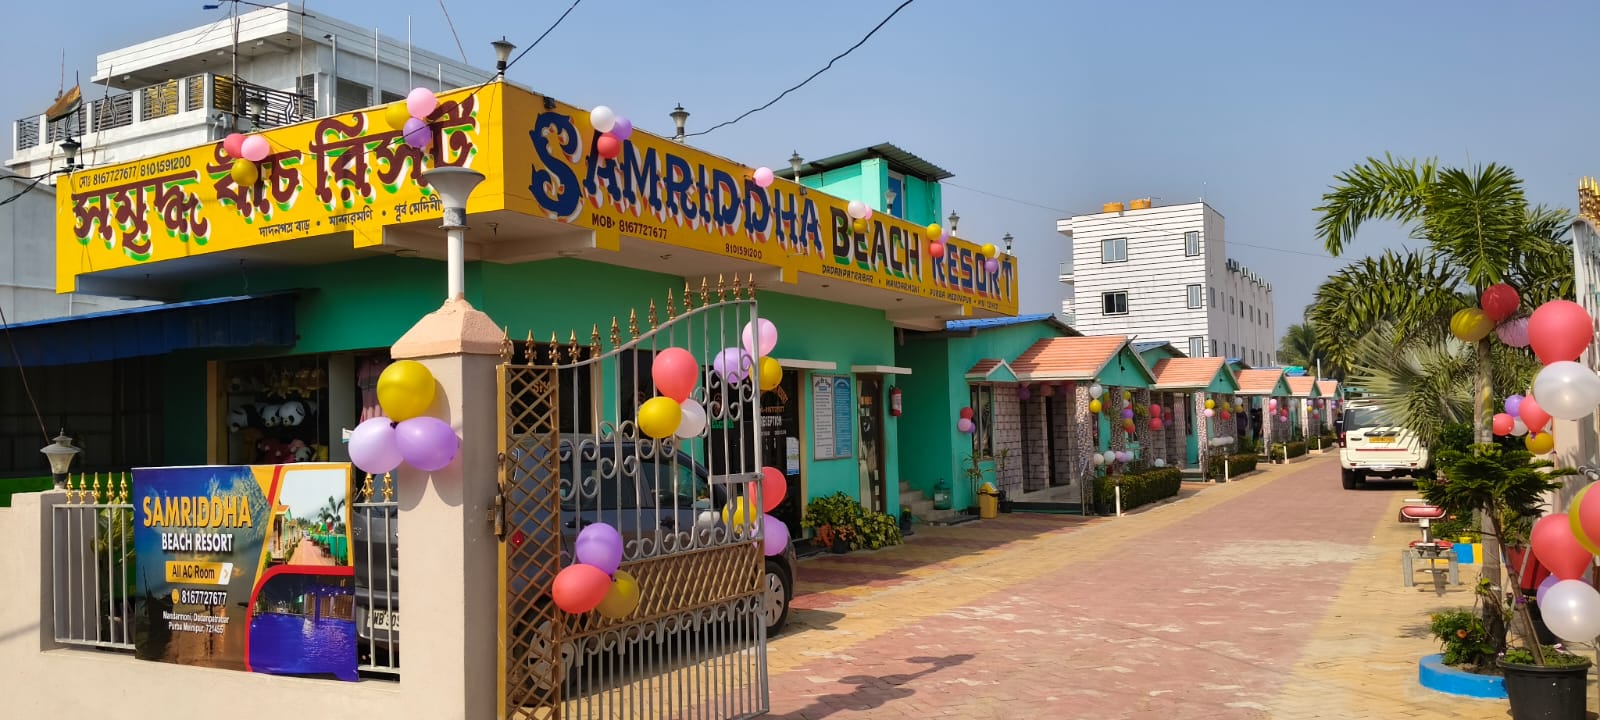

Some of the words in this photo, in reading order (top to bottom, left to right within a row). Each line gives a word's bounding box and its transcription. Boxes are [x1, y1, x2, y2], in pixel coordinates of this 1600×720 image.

[529, 111, 825, 261] SAMRIDDHA
[831, 206, 923, 283] BEACH
[931, 241, 1015, 303] RESORT
[618, 220, 667, 240] 8167727677
[725, 243, 763, 260] 8101591200
[143, 495, 253, 528] SAMRIDDHA
[161, 533, 193, 551] BEACH
[195, 533, 233, 552] RESORT
[180, 566, 192, 578] AC
[193, 566, 215, 579] Room
[181, 590, 227, 606] 8167727677
